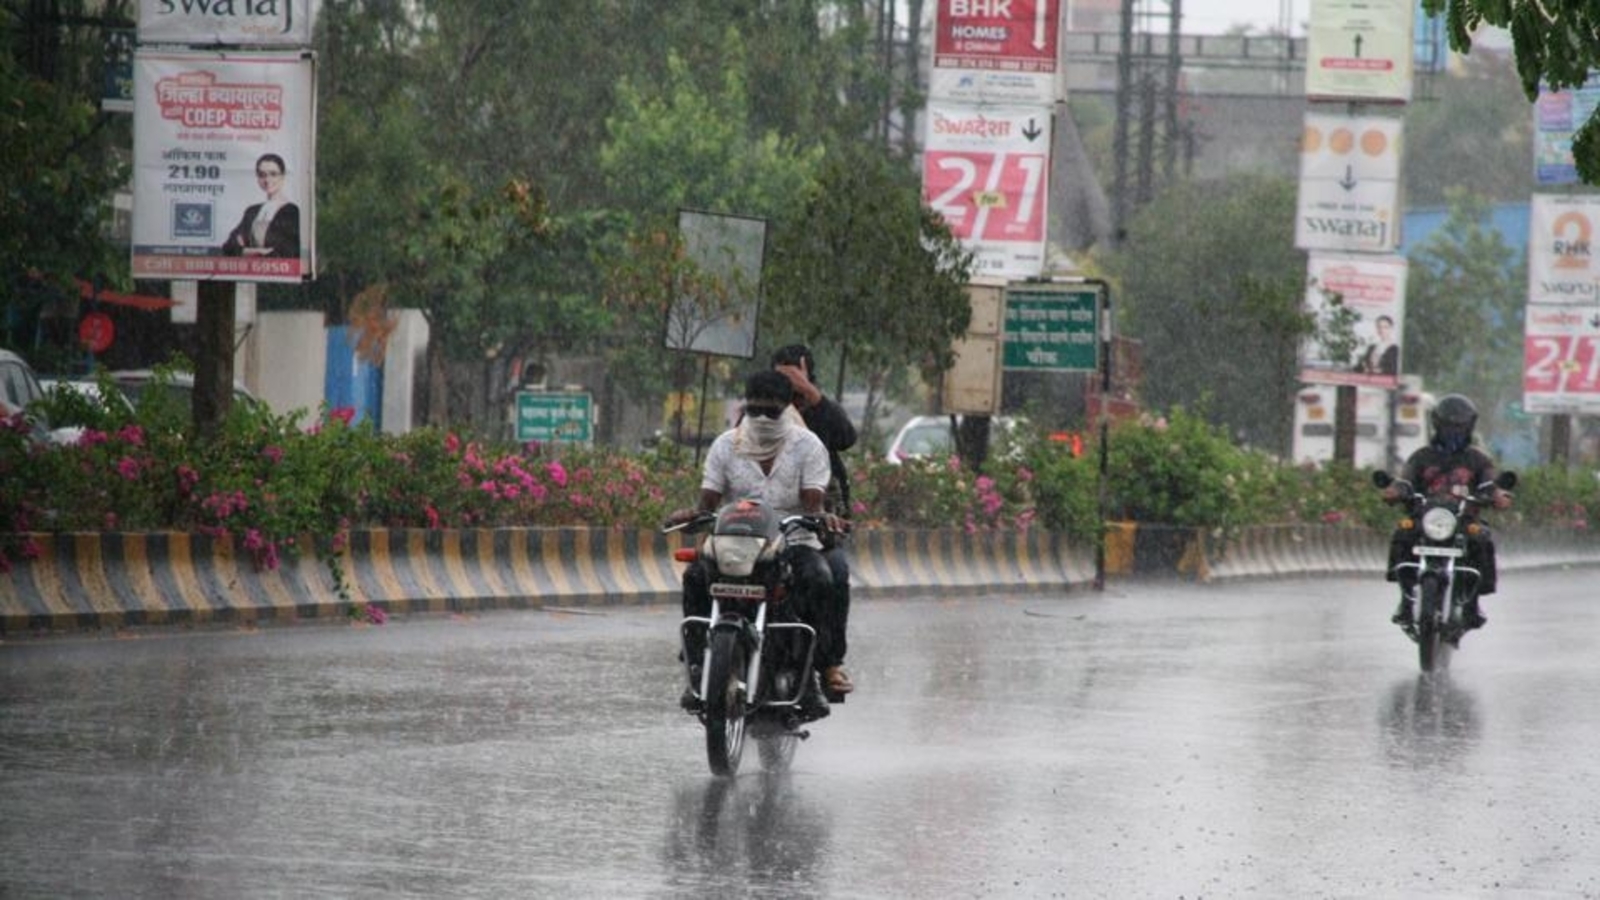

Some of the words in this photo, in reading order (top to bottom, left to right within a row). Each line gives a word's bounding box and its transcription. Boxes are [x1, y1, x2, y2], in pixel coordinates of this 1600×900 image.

[950, 0, 1012, 18] BHK
[951, 26, 1007, 40] HOMES
[184, 107, 227, 126] COEP
[168, 164, 221, 179] 21.90
